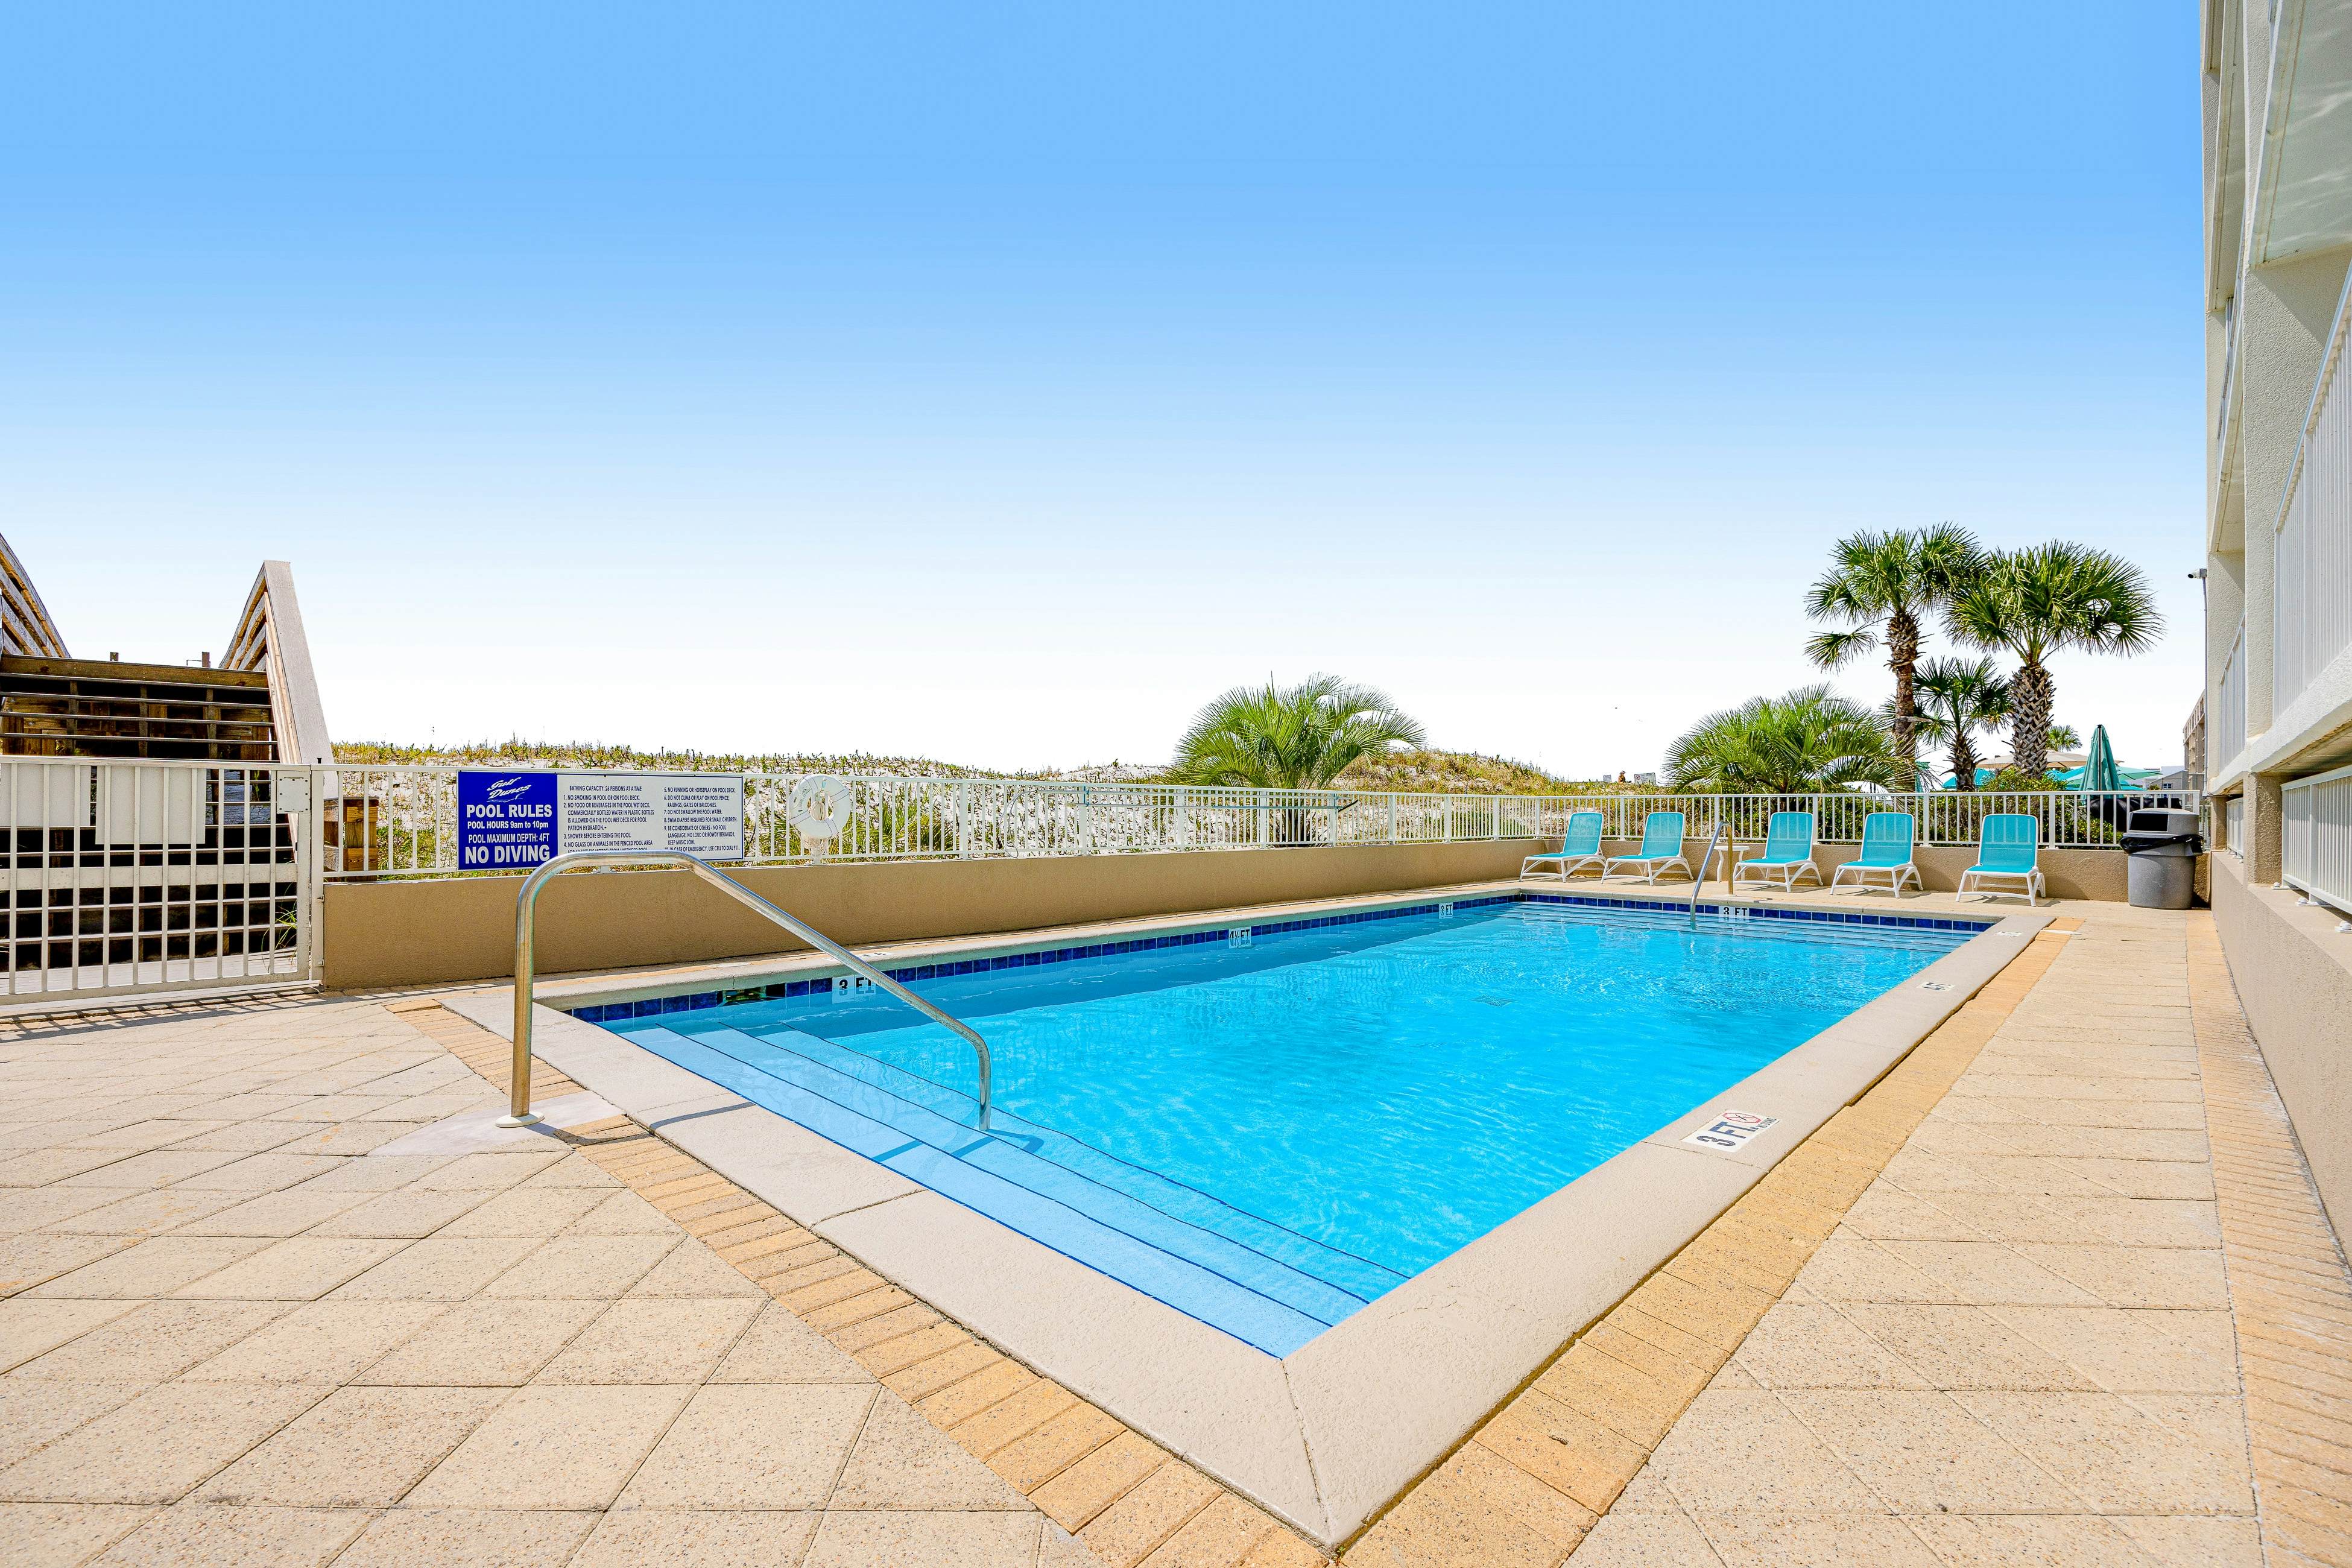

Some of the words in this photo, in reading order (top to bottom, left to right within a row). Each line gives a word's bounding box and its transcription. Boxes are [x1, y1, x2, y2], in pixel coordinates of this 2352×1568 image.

[487, 777, 522, 791] Gulf
[488, 785, 531, 800] Dunes
[467, 805, 504, 818] POOL
[508, 805, 552, 818] RULES
[533, 821, 548, 829] 10pm
[469, 834, 485, 844] POOL
[487, 833, 516, 843] MAXIMUM
[517, 833, 538, 842] DEPTH:
[539, 833, 549, 842] 4FT
[465, 846, 489, 864] NO
[495, 845, 550, 863] DIVING
[1735, 908, 1748, 916] FT
[1696, 1135, 1736, 1146] 3
